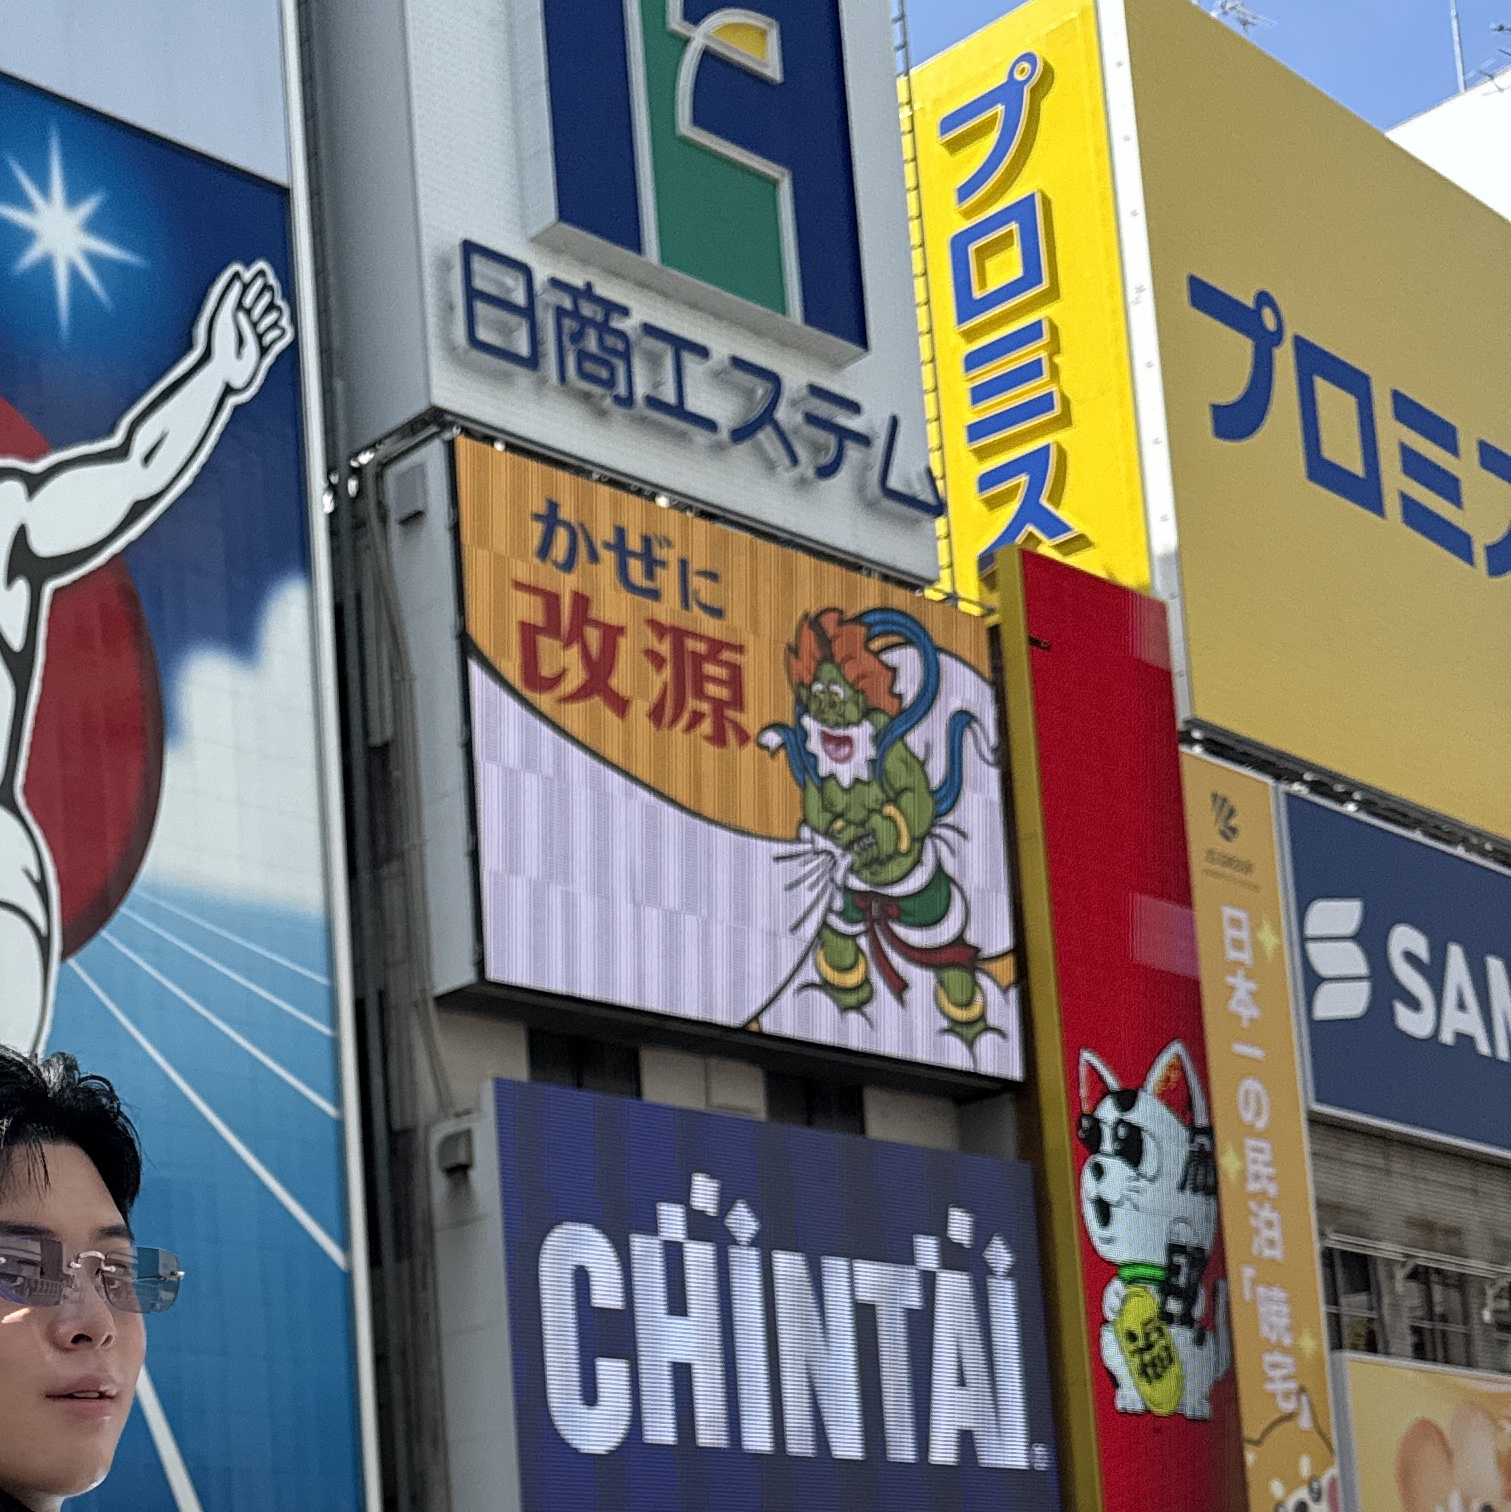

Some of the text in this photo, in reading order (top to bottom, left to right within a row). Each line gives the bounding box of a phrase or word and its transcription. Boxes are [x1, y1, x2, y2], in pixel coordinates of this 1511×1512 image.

[938, 50, 1081, 576] プロミス
[512, 579, 752, 749] 改源
[532, 498, 725, 620] かぜに
[538, 1172, 1030, 1470] CHINTAI
